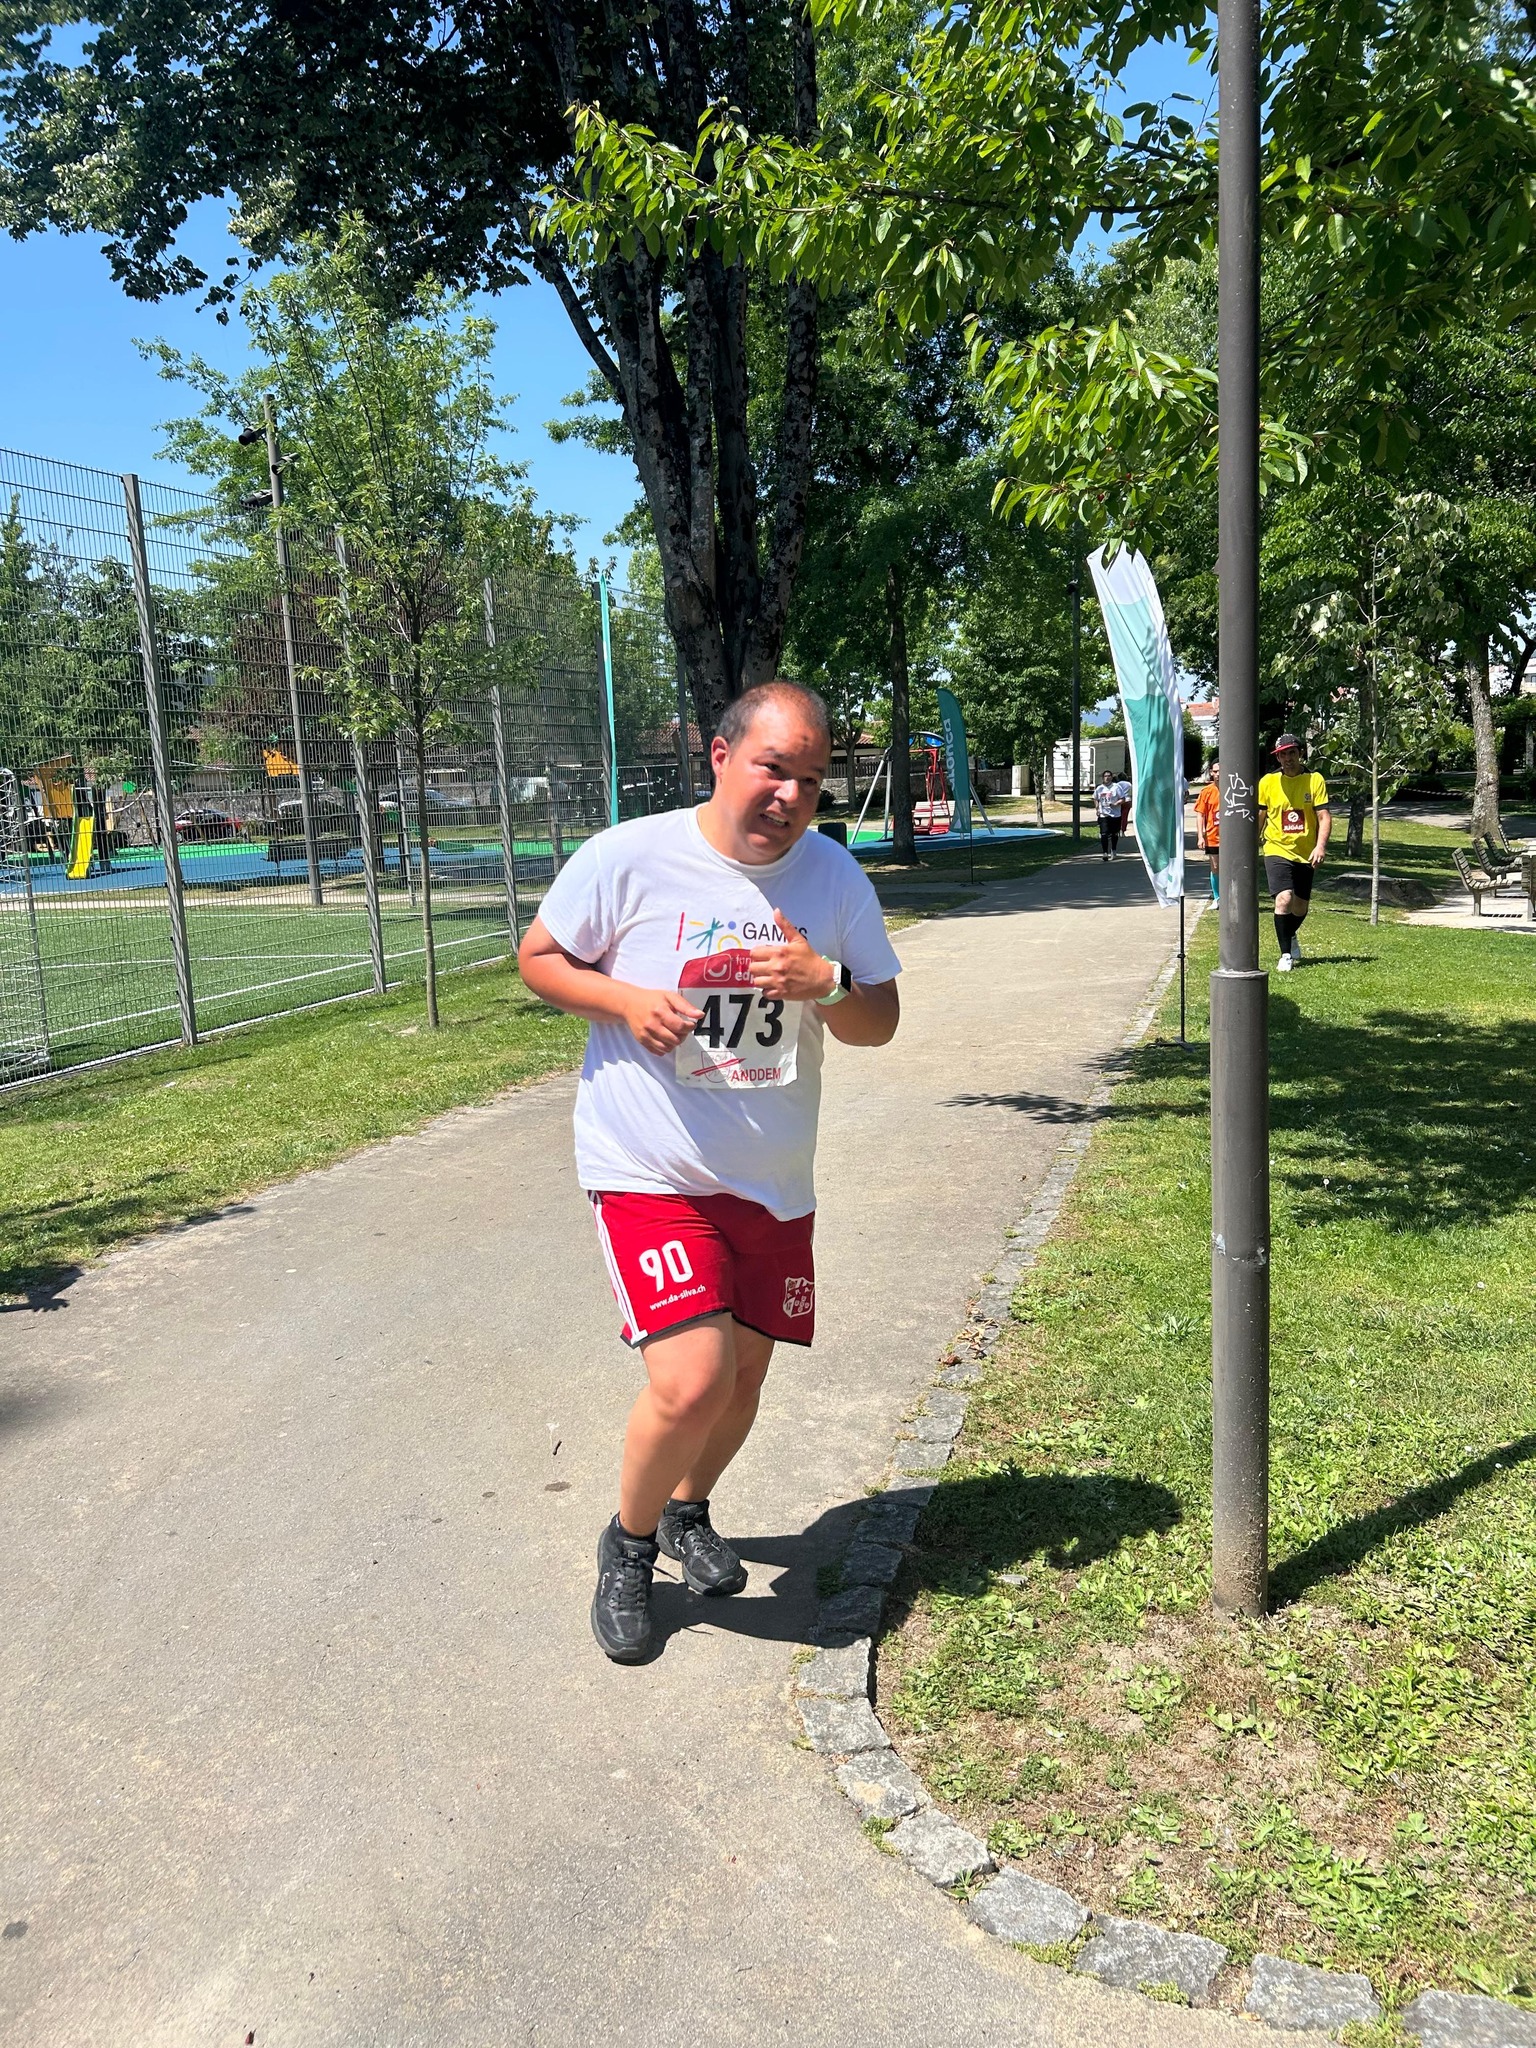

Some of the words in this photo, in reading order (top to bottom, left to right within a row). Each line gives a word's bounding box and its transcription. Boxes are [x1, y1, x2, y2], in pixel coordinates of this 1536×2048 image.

[742, 921, 809, 943] GAMS
[693, 993, 786, 1050] 473
[730, 1067, 782, 1083] ANDDEM
[639, 1240, 693, 1292] 90
[649, 1284, 707, 1311] www.da-silva.ch
